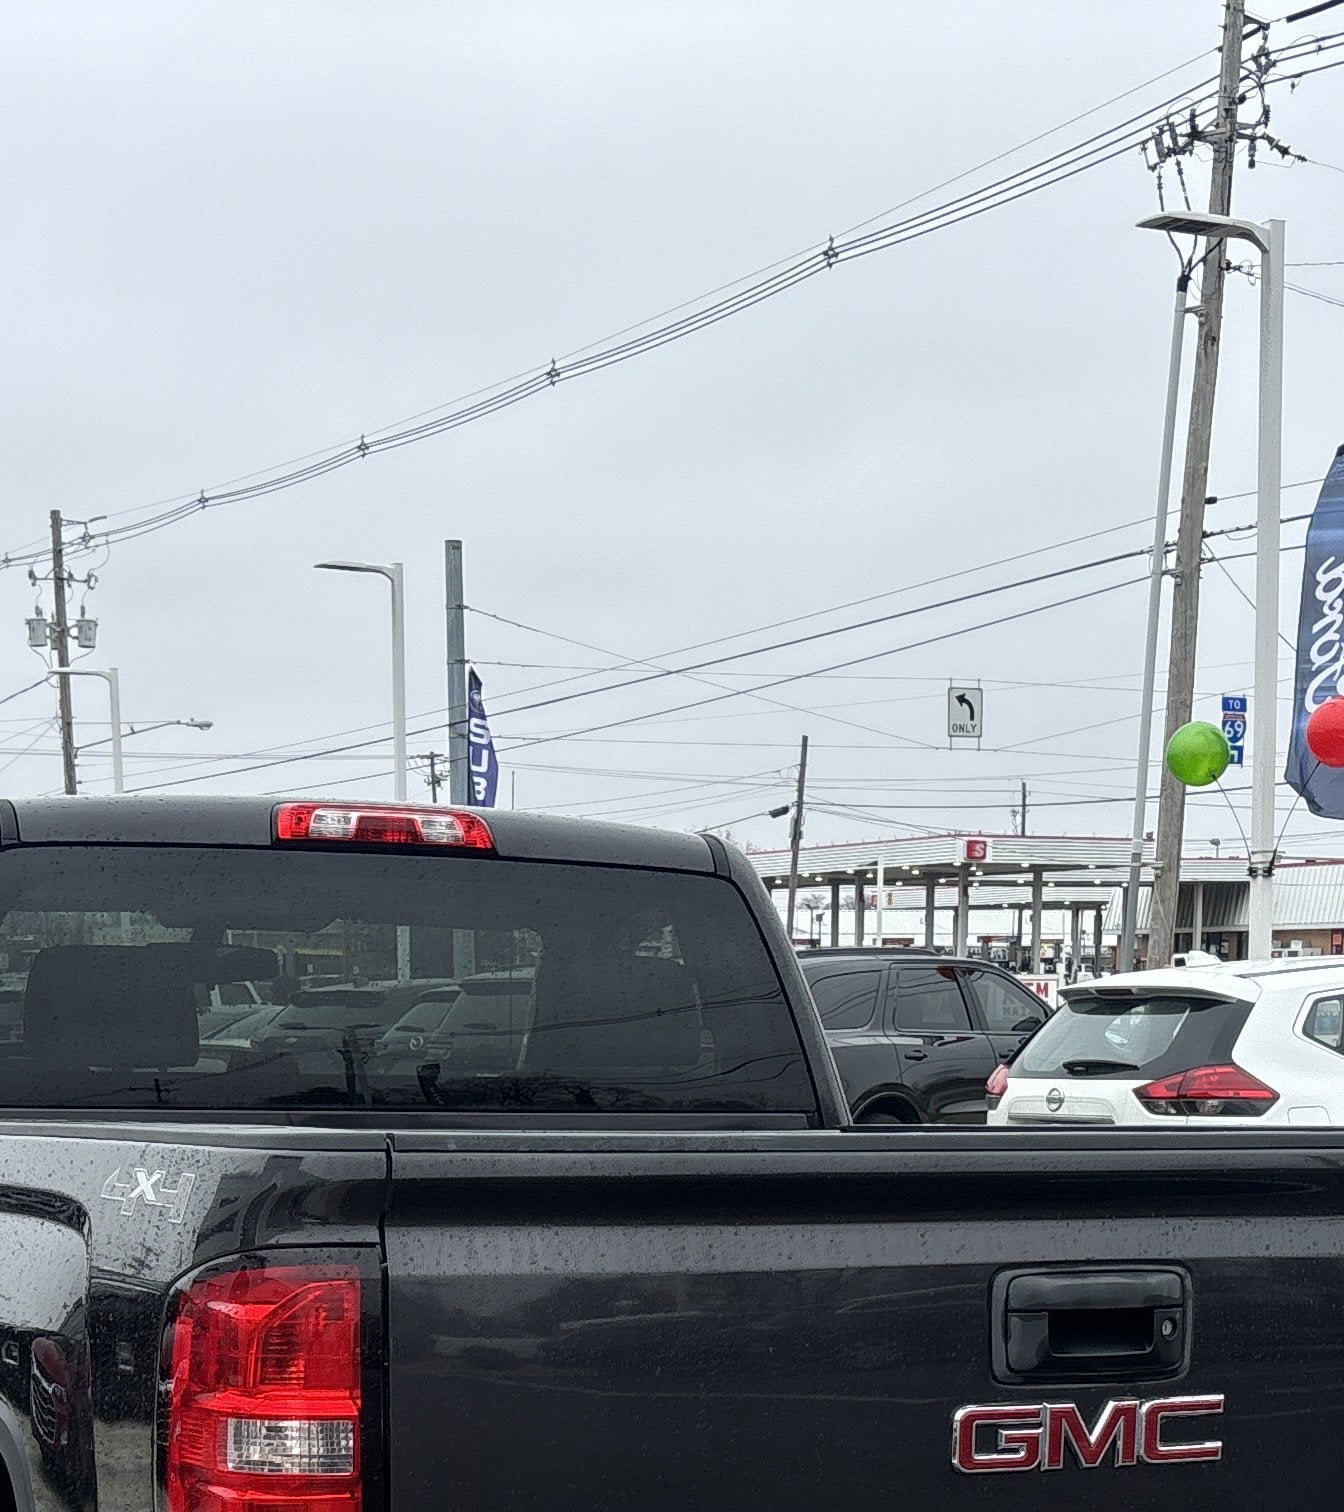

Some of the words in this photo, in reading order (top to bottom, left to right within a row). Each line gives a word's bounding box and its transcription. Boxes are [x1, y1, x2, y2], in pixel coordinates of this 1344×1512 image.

[1228, 699, 1241, 710] TO
[951, 723, 977, 733] ONLY
[1225, 720, 1244, 738] 69
[952, 1394, 1225, 1473] GMC
